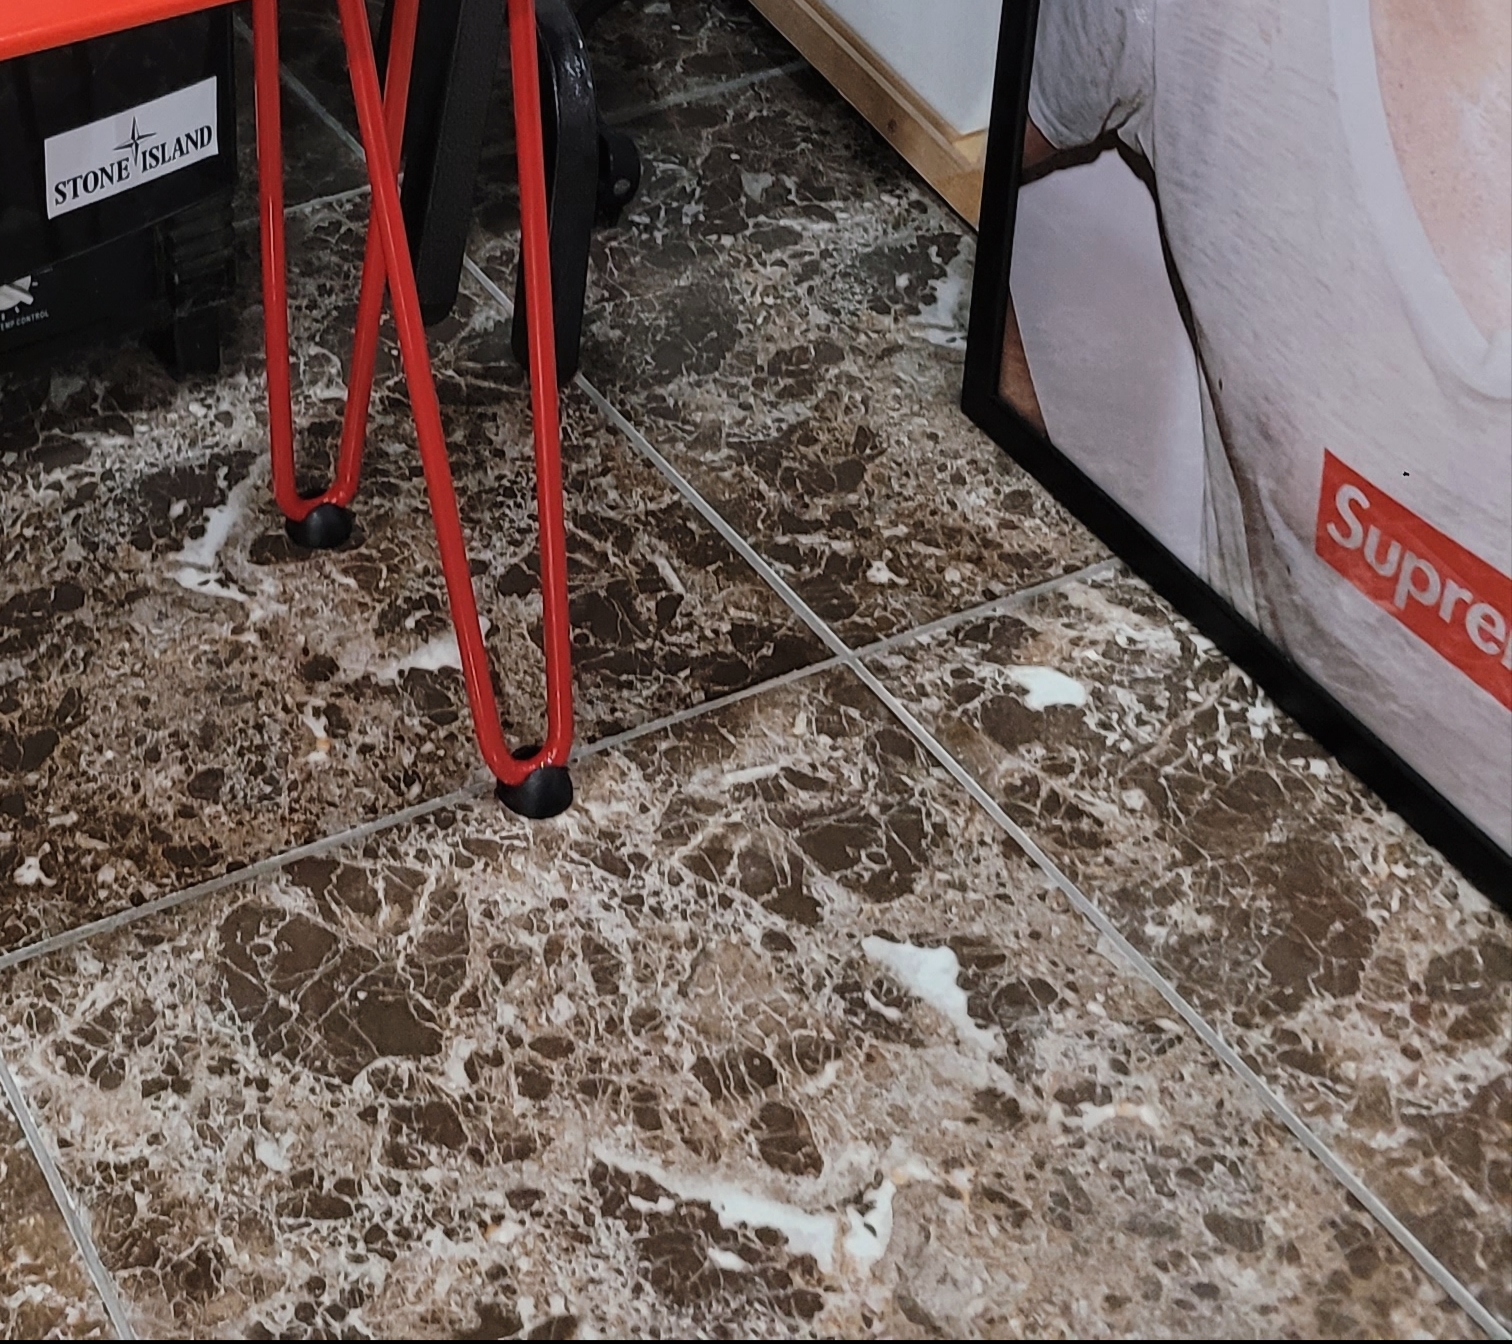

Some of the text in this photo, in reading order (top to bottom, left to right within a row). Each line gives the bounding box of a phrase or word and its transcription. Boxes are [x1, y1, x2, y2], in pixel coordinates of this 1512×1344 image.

[54, 123, 214, 207] STONE ISLAND
[15, 308, 50, 327] CONTROL
[1324, 483, 1512, 670] Supre
